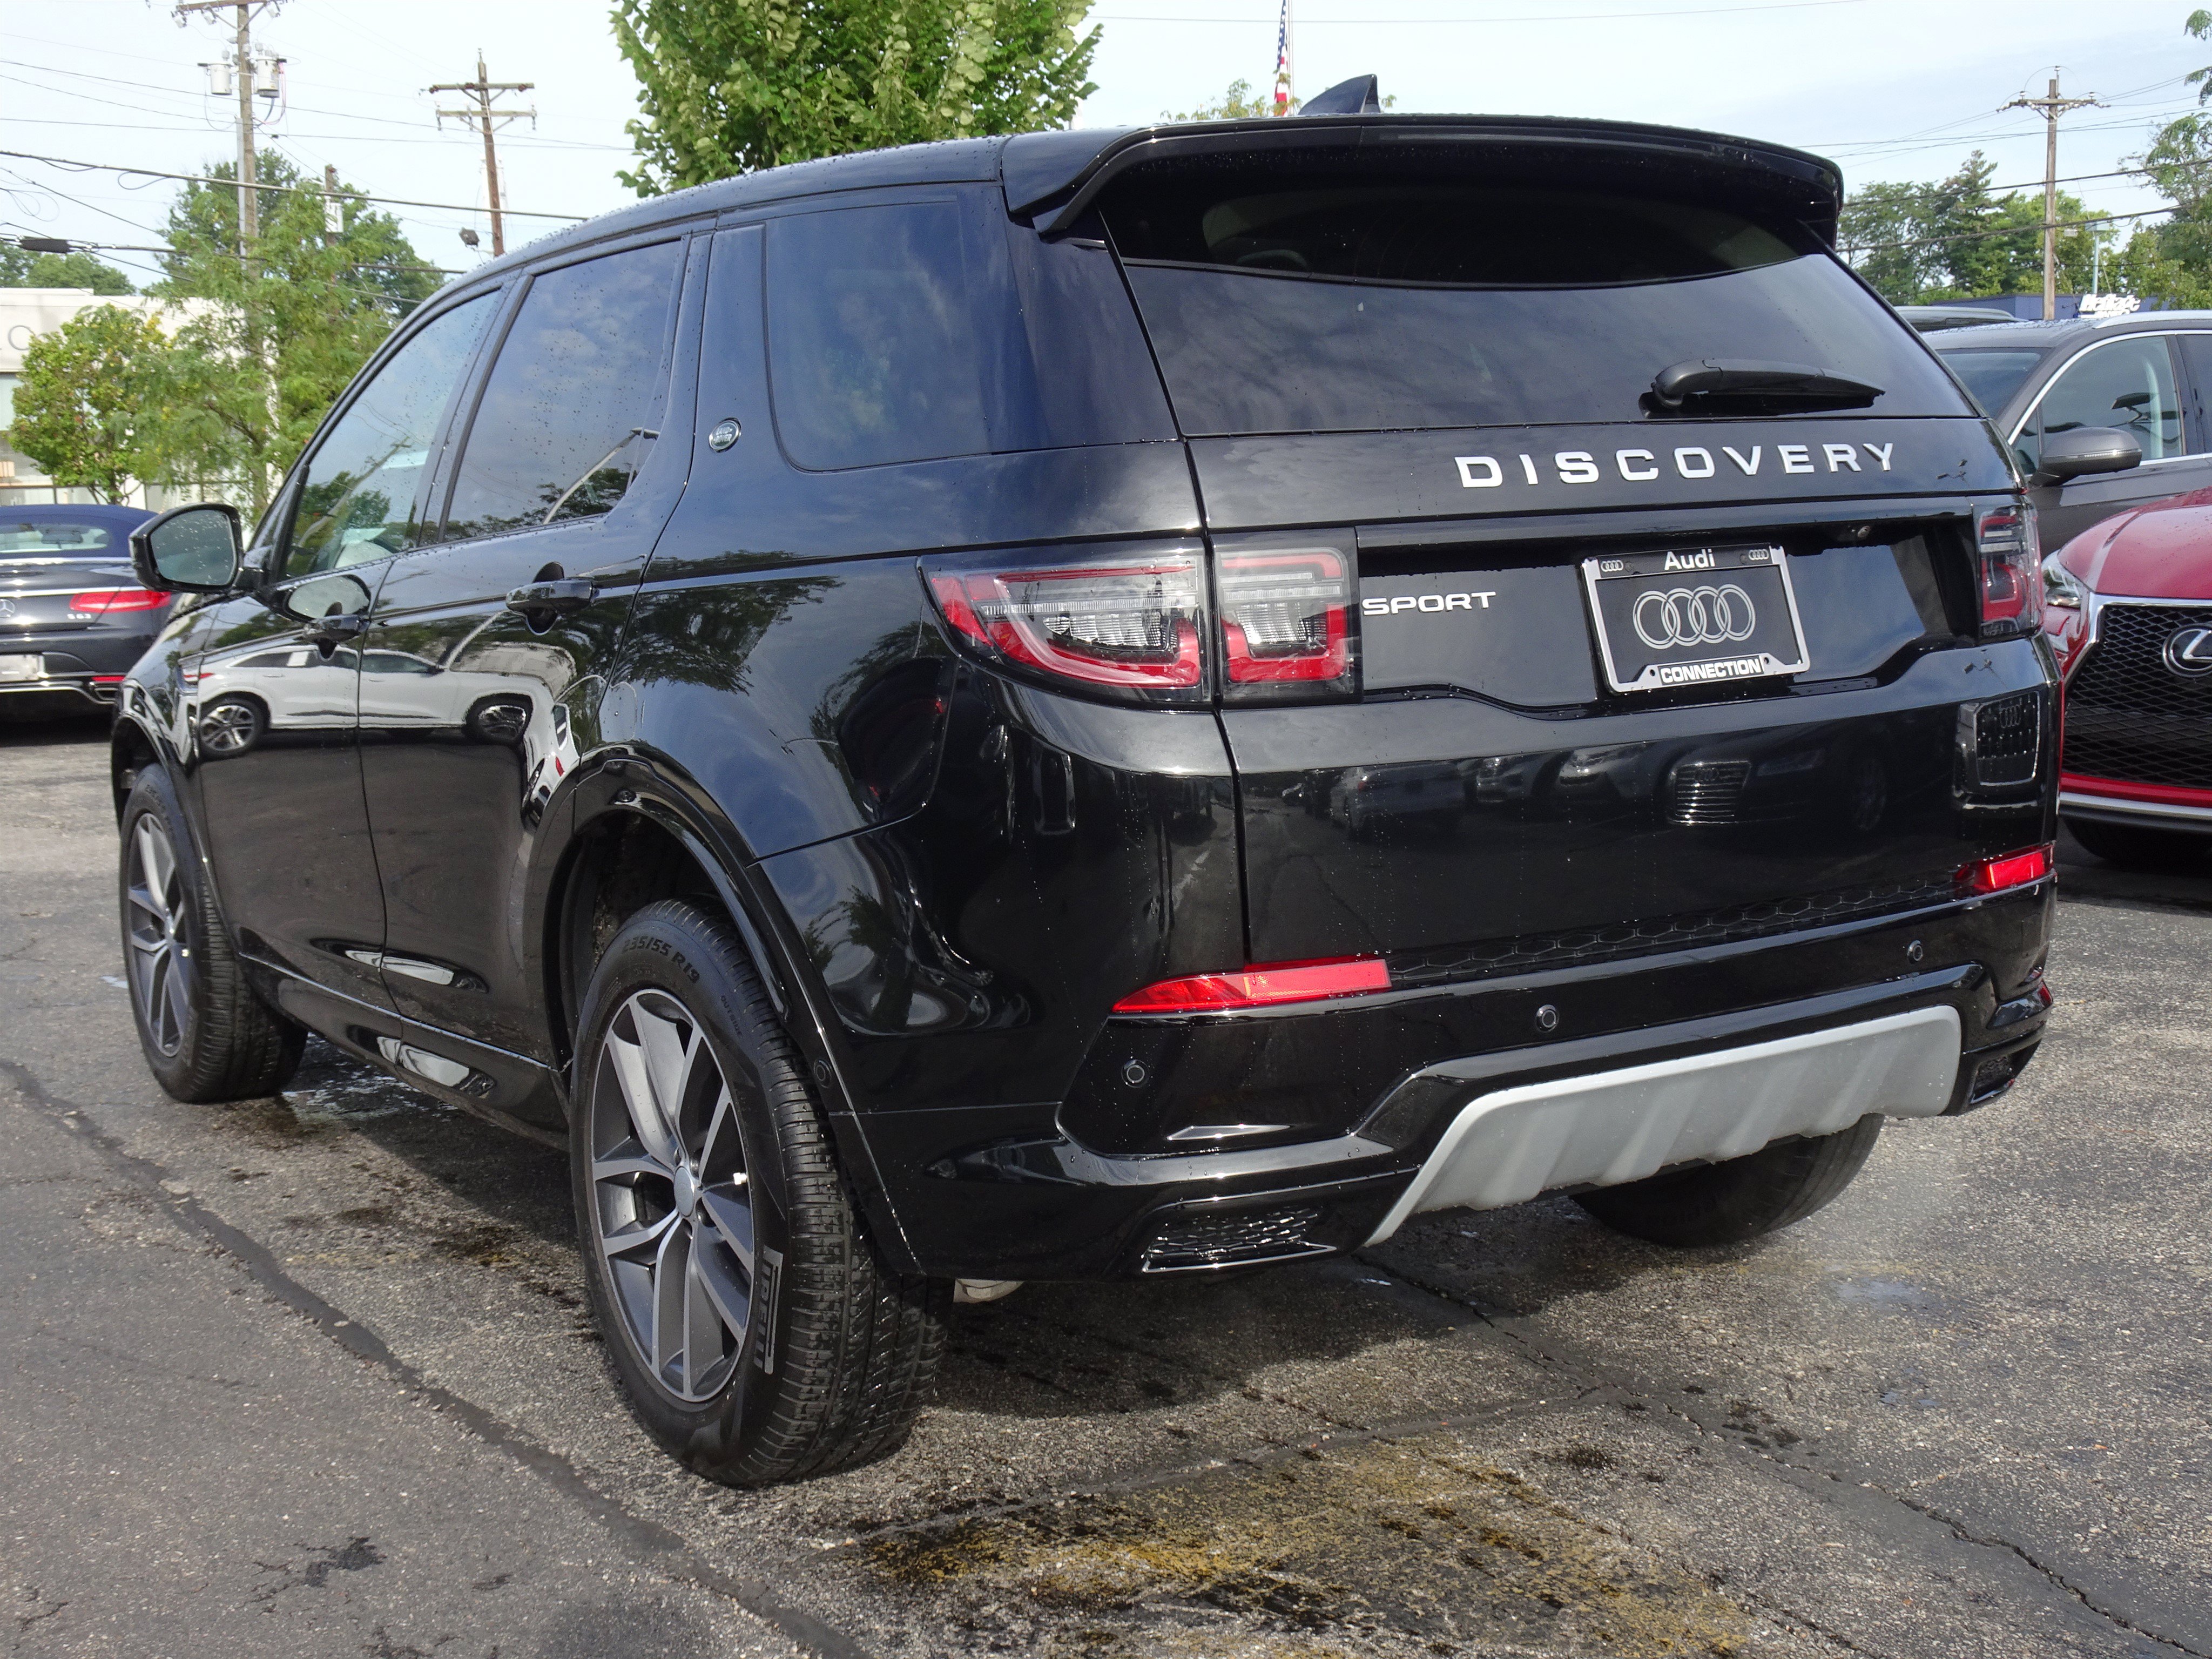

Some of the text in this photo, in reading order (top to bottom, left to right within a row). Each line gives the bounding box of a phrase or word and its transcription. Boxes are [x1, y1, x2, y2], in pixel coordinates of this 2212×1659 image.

[1454, 442, 1893, 488] DISCOVERY
[1664, 549, 1715, 570] Audi
[1361, 591, 1496, 616] SPORT
[1660, 658, 1761, 683] CONNECTION
[622, 936, 700, 984] 235/55 R19
